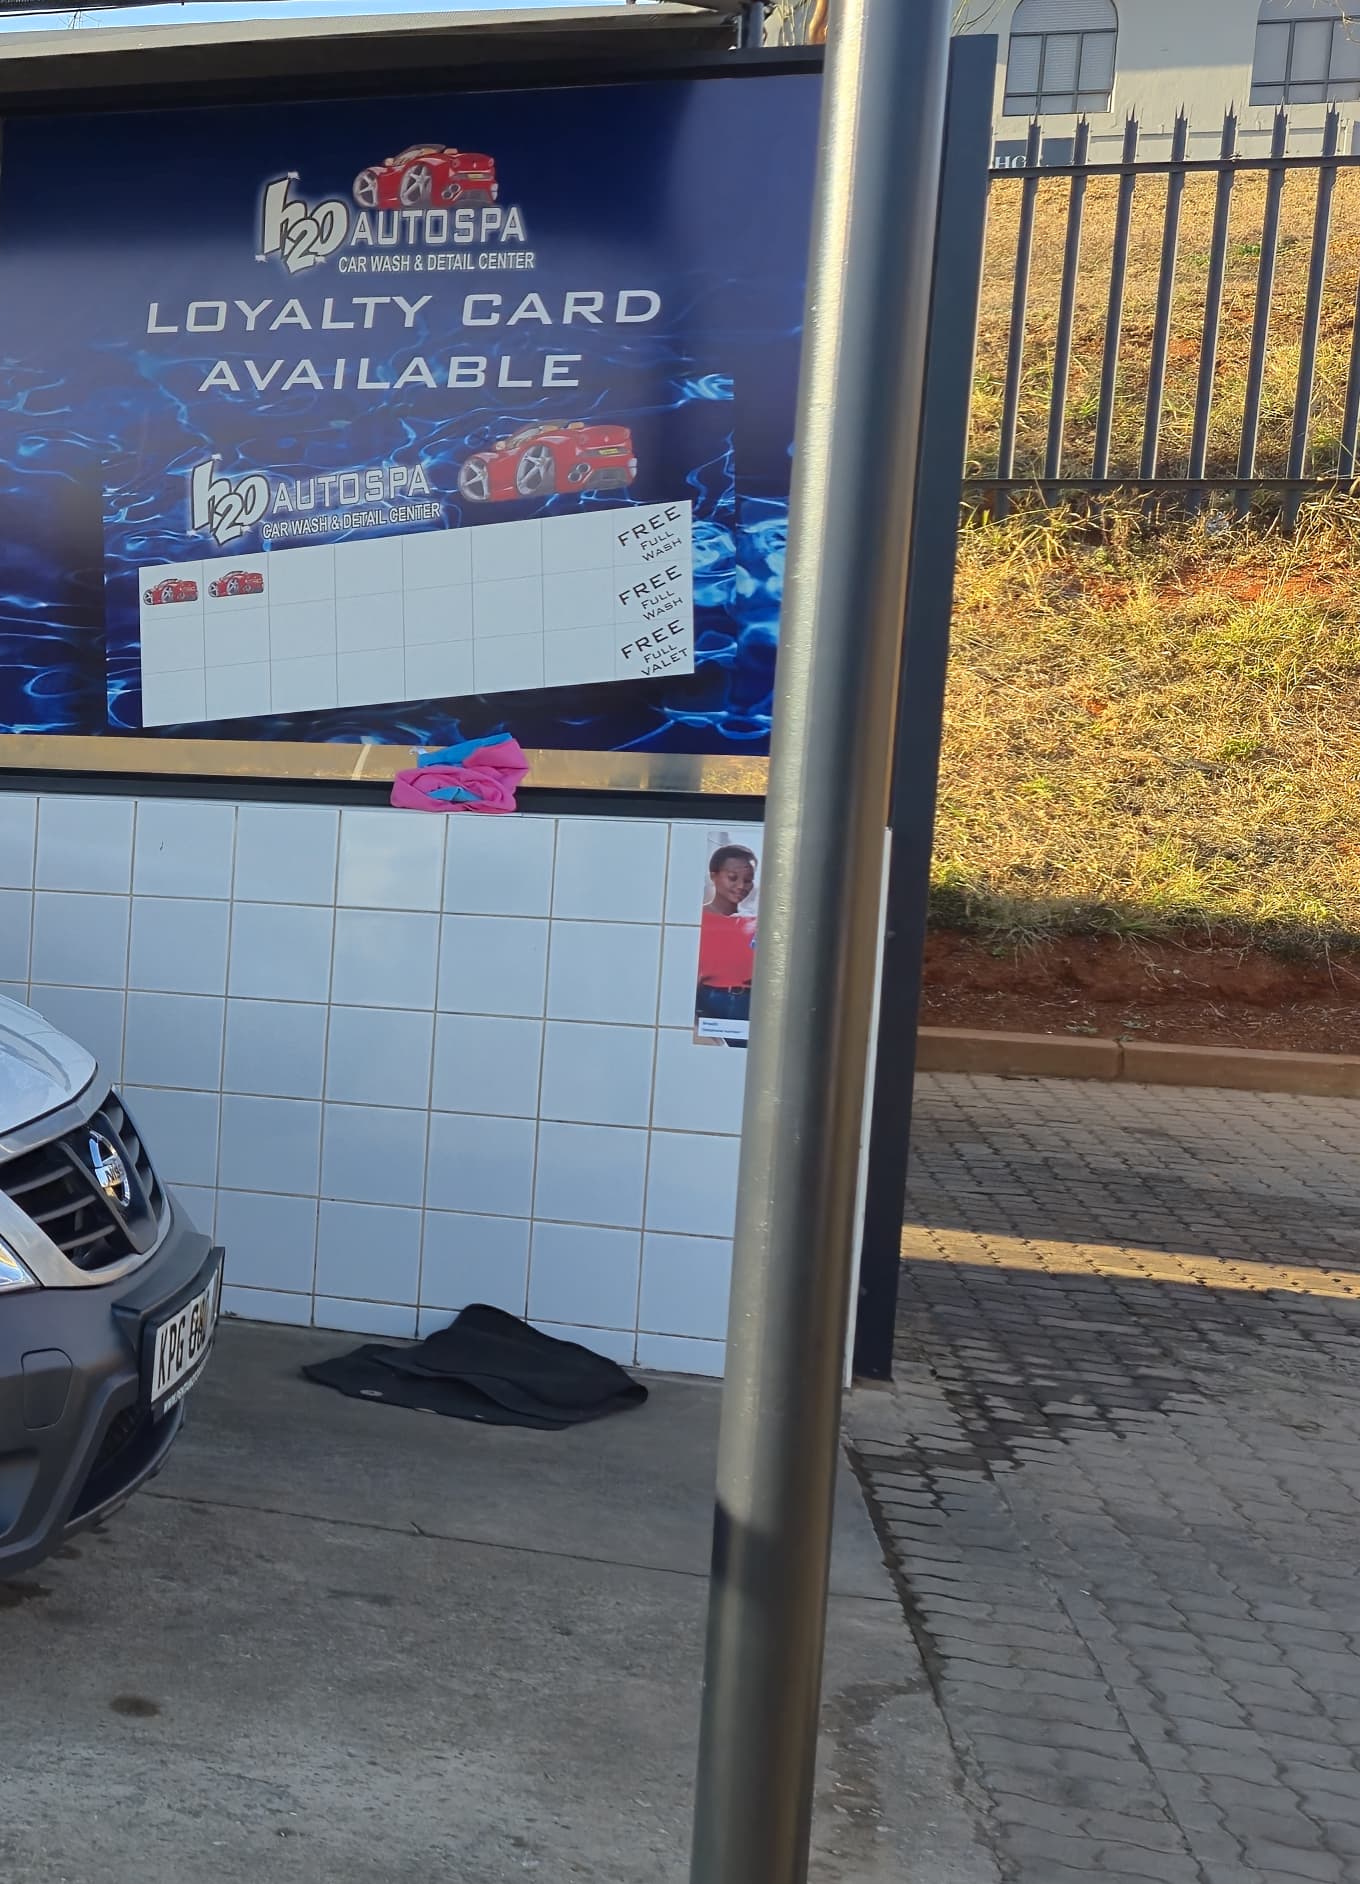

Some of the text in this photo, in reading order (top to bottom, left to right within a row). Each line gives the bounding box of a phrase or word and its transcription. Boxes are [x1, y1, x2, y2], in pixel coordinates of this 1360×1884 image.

[351, 206, 525, 246] AUTOSPA
[339, 252, 534, 272] CAR WASH & DETAIL CENTER
[146, 289, 661, 333] LOYALTY CARD
[198, 354, 583, 391] AVAILABLE
[272, 464, 430, 515] AUTOSPA
[262, 502, 440, 539] CAR WASH & DETAIL CENTER
[617, 506, 681, 547] FREE
[640, 531, 675, 550] FULL
[642, 538, 682, 561] WASH
[619, 565, 682, 606] FREE
[641, 590, 675, 610] FULL
[643, 597, 683, 621] WASH
[621, 620, 684, 660] FREE
[644, 645, 678, 663] FULL
[641, 648, 688, 676] VALET
[157, 1315, 186, 1390] KPG
